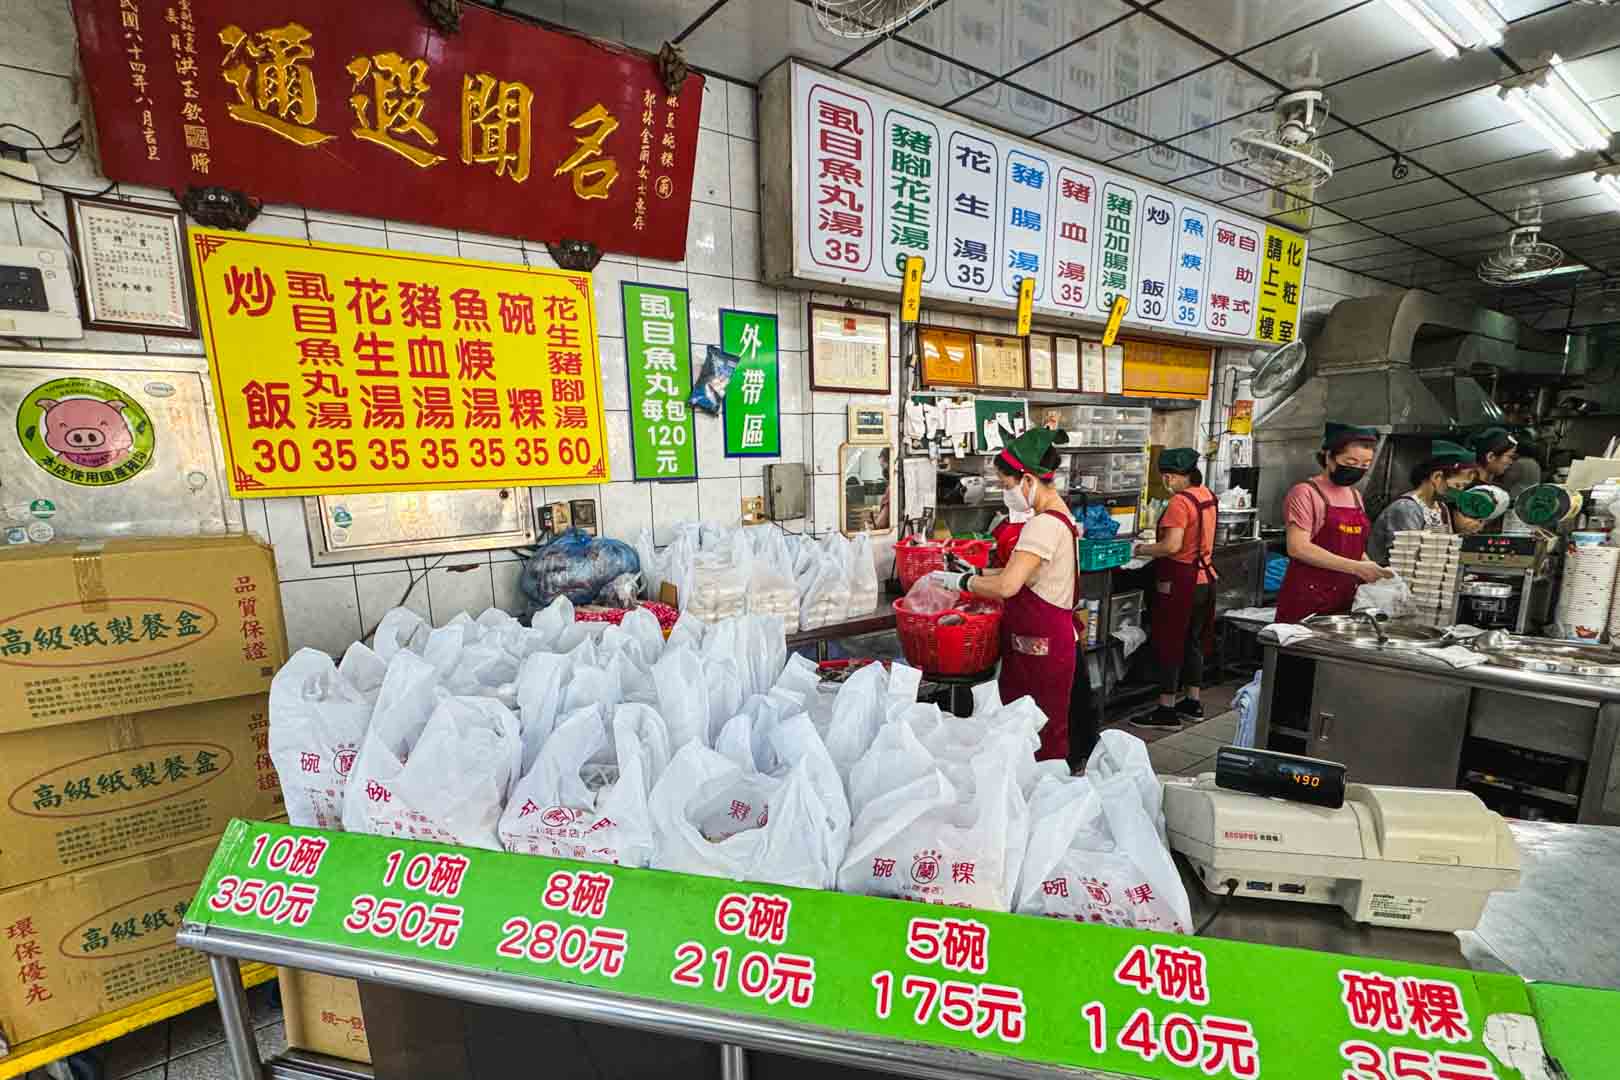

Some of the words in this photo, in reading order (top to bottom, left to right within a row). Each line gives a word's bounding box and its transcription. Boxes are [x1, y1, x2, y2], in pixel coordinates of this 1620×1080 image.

[817, 100, 865, 239] 虱目魚丸湯
[890, 123, 932, 251] 豬腳花生湯
[955, 145, 991, 263] 花生湯
[1008, 162, 1045, 273] 豬腸湯
[1057, 178, 1091, 283] 豬血湯
[824, 238, 860, 264] 35
[1101, 192, 1132, 291] 豬血加腸湯
[1141, 206, 1170, 299] 炒飯
[1210, 227, 1235, 311] 碗粿
[957, 265, 985, 286] 35
[1061, 284, 1083, 303] 35
[1232, 236, 1257, 316] 自助式
[1259, 235, 1283, 341] 請上二樓
[1142, 299, 1162, 316] 30
[1178, 305, 1196, 322] 35
[1211, 311, 1227, 328] 35
[224, 265, 296, 431] 炒飯
[285, 269, 353, 430] 虱目魚丸湯
[344, 276, 405, 430] 花生湯
[397, 280, 455, 430] 豬血湯
[449, 287, 501, 430] 魚焿湯
[497, 291, 546, 430] 碗粿
[543, 295, 589, 430] 花生豬腳湯
[639, 294, 679, 396] 虱目魚丸
[641, 399, 687, 422] 每包
[739, 322, 766, 450] 外帶區
[252, 439, 301, 475] 30
[311, 438, 358, 474] 35
[367, 438, 410, 471] 35
[420, 438, 460, 469] 35
[469, 437, 506, 468] 35
[514, 437, 549, 467] 35
[558, 436, 591, 466] 60
[647, 425, 687, 446] 120
[656, 450, 678, 473] 元
[0, 609, 203, 657] 高級紙製餐盒
[234, 575, 268, 662] 品質保證
[32, 749, 220, 811] 高級紙製餐盒
[301, 751, 321, 773] 碗
[249, 832, 328, 876] 10碗
[384, 850, 469, 895] 10碗
[872, 856, 897, 879] 碗
[951, 861, 977, 885] 粿
[209, 876, 320, 926] 350元
[543, 872, 612, 917] 8碗
[1042, 877, 1069, 898] 碗
[344, 895, 464, 949] 350元
[716, 893, 790, 943] 6碗
[908, 917, 988, 972] 5碗
[5, 915, 54, 1006] 環保優先
[498, 919, 626, 978] 280元
[672, 944, 814, 1007] 210元
[1116, 944, 1209, 1003] 4碗
[873, 970, 1025, 1043] 175元
[1340, 969, 1472, 1043] 碗粿
[1082, 1001, 1259, 1079] 140元
